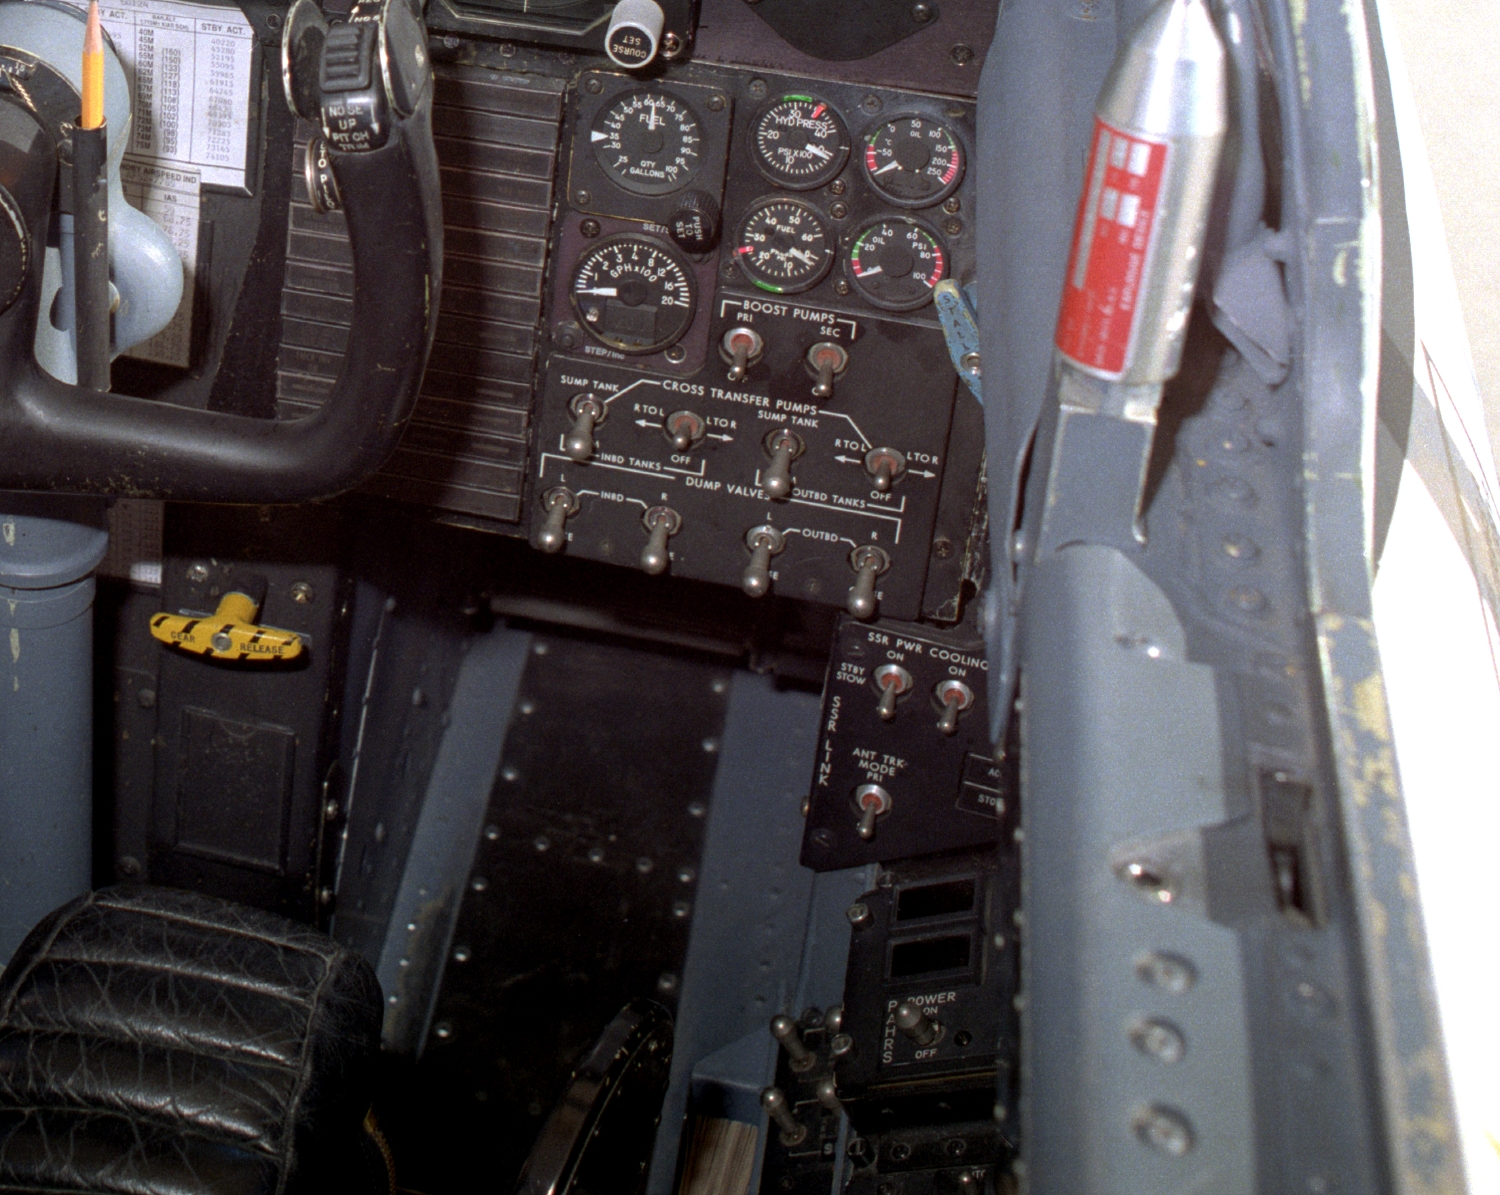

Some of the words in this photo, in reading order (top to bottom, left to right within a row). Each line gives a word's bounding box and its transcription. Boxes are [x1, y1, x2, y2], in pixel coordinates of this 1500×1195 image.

[201, 23, 222, 31] STBY
[226, 26, 246, 35] ACT.
[775, 116, 796, 125] HYD
[796, 118, 828, 130] PRESS
[630, 167, 665, 178] GALLONS
[737, 313, 753, 322] PRI
[743, 301, 788, 317] BOOST
[793, 308, 835, 324] PUMPS
[820, 326, 841, 338] SEC
[560, 375, 588, 386] SUMP
[593, 381, 619, 392] TANK
[662, 380, 705, 396] CROSS
[711, 388, 770, 408] TRANSFER
[776, 399, 818, 415] PUMPS
[758, 410, 786, 422] SUMP
[790, 416, 819, 428] TANK
[601, 452, 625, 464] INBD
[628, 457, 662, 470] TANKS
[671, 454, 691, 465] OFF
[685, 477, 722, 491] DUMP
[727, 483, 771, 501] VALVES
[870, 491, 892, 501] OFF
[600, 491, 625, 502] INBD
[792, 487, 828, 501] OUTBD
[832, 495, 866, 508] TANKS
[802, 528, 839, 542] OUTBD
[171, 631, 195, 643] GEAR
[240, 643, 284, 654] RELEASE
[868, 632, 889, 645] SSR
[896, 639, 922, 654] PWR
[887, 650, 905, 661] ON
[929, 648, 989, 670] COOLING
[841, 662, 865, 675] STBY
[948, 666, 966, 677] ON
[836, 671, 866, 685] STOW
[828, 696, 841, 732] SSR
[819, 739, 832, 786] LINK
[853, 748, 876, 760] ANT
[883, 755, 905, 768] TRK
[858, 759, 896, 777] MODE
[867, 772, 883, 782] PRI
[923, 1006, 938, 1015] ON
[883, 1000, 898, 1063] PAHRS
[915, 1048, 937, 1059] OFF
